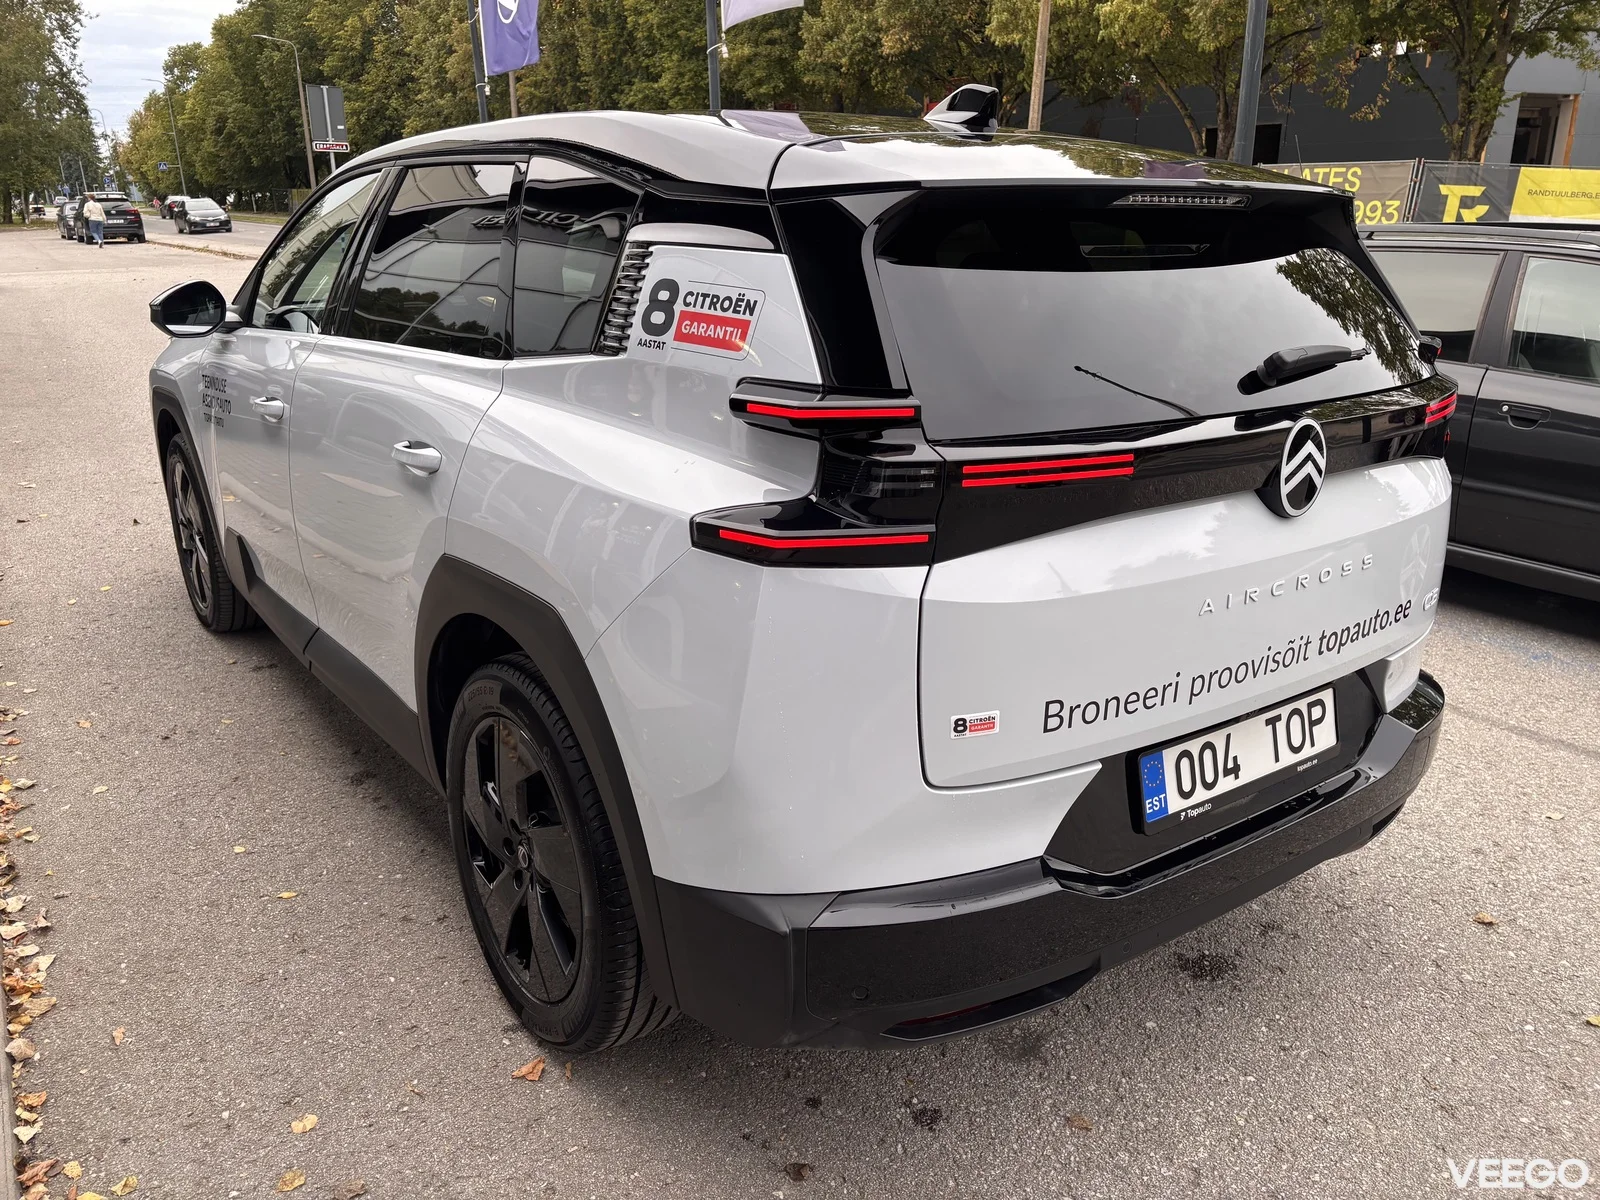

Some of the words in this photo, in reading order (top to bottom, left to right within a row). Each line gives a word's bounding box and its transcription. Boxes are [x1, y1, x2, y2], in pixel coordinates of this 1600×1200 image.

[641, 278, 680, 337] 8
[682, 291, 758, 317] CITROËN
[681, 320, 742, 342] GARANTII
[637, 338, 667, 350] AASTAT
[1199, 554, 1373, 616] AIRCROSS
[1042, 672, 1181, 734] Broneeri
[1188, 635, 1312, 705] proovisõit
[1317, 599, 1412, 655] topauto.ee
[953, 717, 968, 734] 8
[1175, 733, 1241, 800] 004
[1265, 698, 1327, 764] TOP
[1145, 793, 1166, 814] EST
[1187, 803, 1212, 818] Topauto
